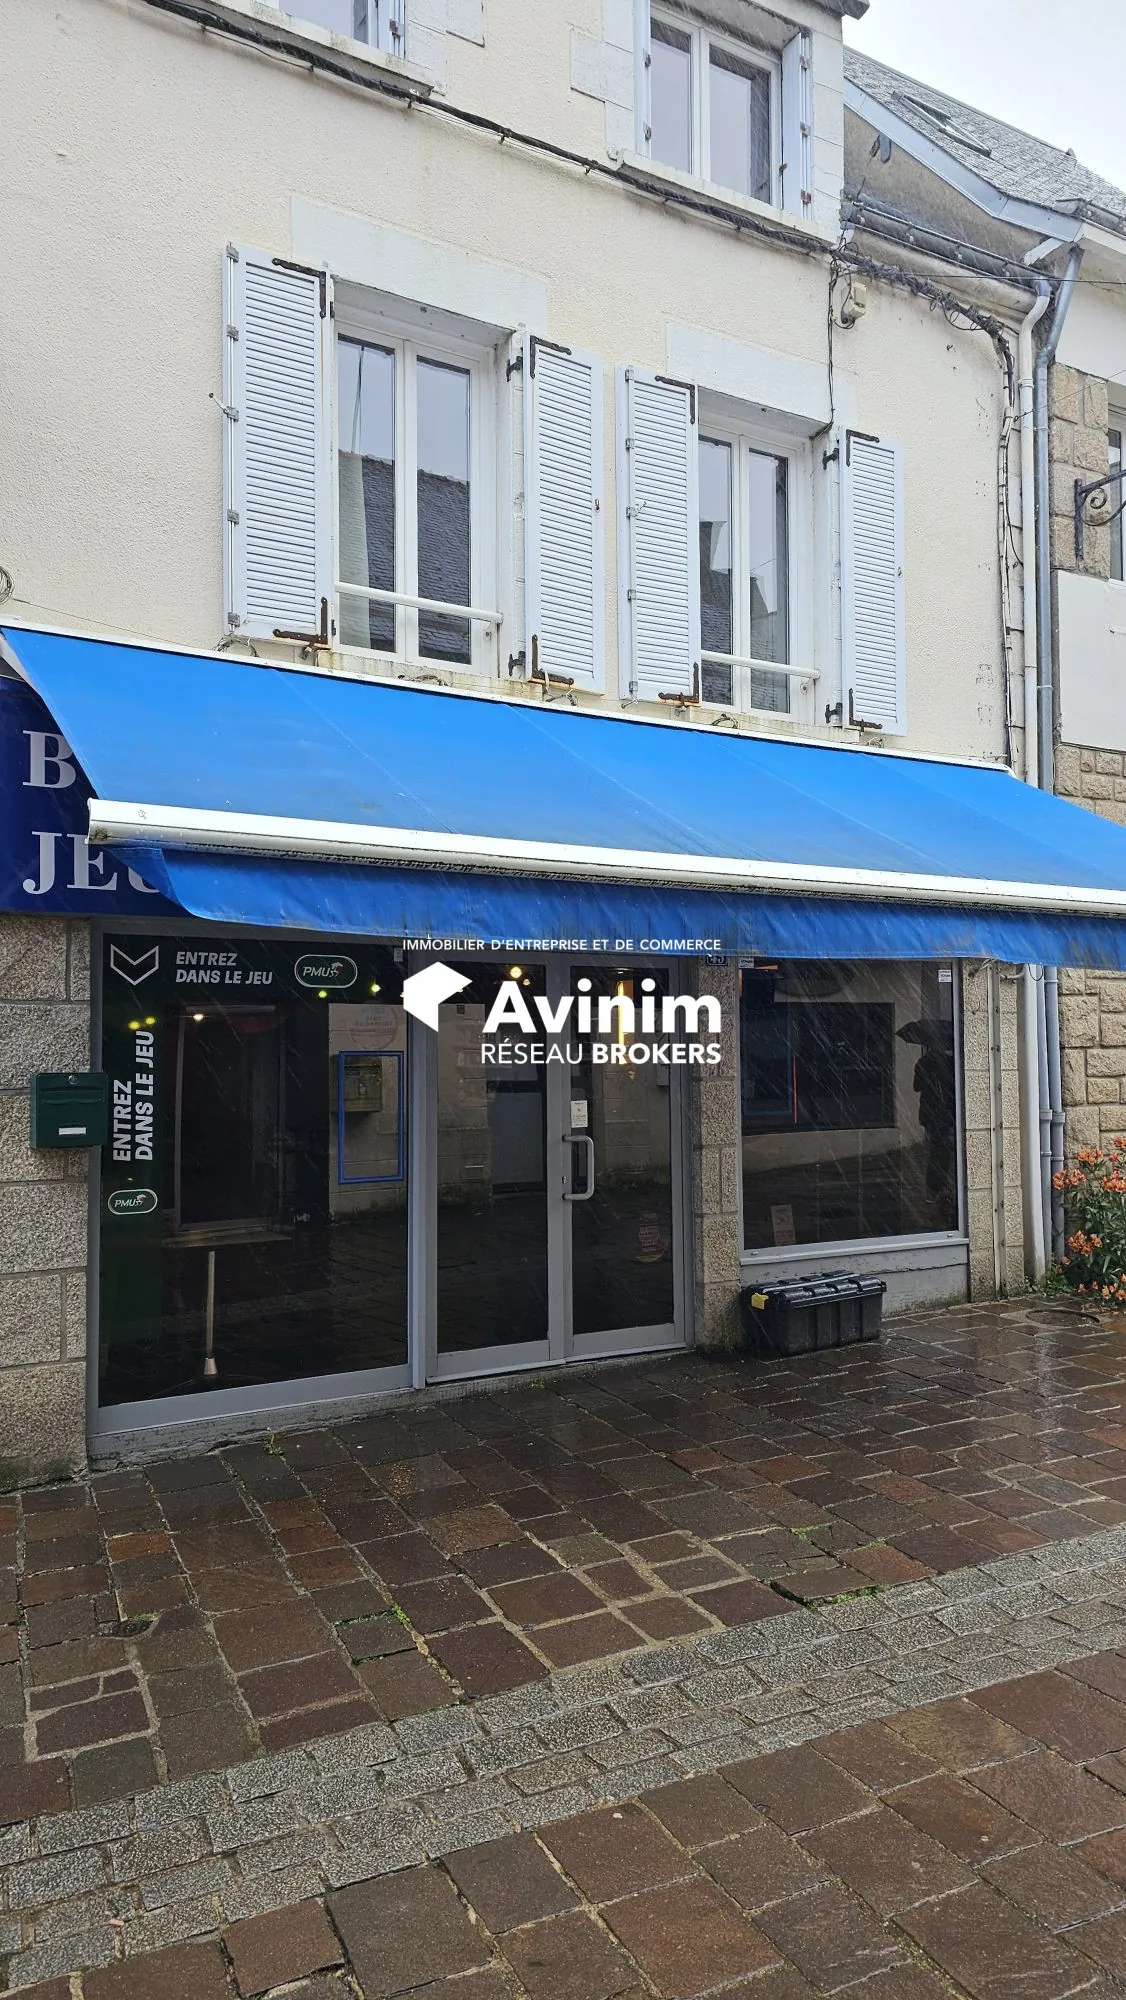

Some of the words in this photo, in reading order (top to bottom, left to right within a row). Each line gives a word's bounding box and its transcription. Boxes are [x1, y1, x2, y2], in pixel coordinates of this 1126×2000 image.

[176, 951, 237, 966] ENTREZ
[175, 969, 221, 984] DANS
[224, 970, 242, 984] LE
[245, 971, 273, 985] JEU
[303, 966, 330, 977] PMU
[136, 1030, 154, 1069] JEU
[136, 1072, 154, 1096] LE
[113, 1079, 132, 1162] ENTREZ
[135, 1101, 154, 1161] DANS
[114, 1199, 138, 1208] PMU
